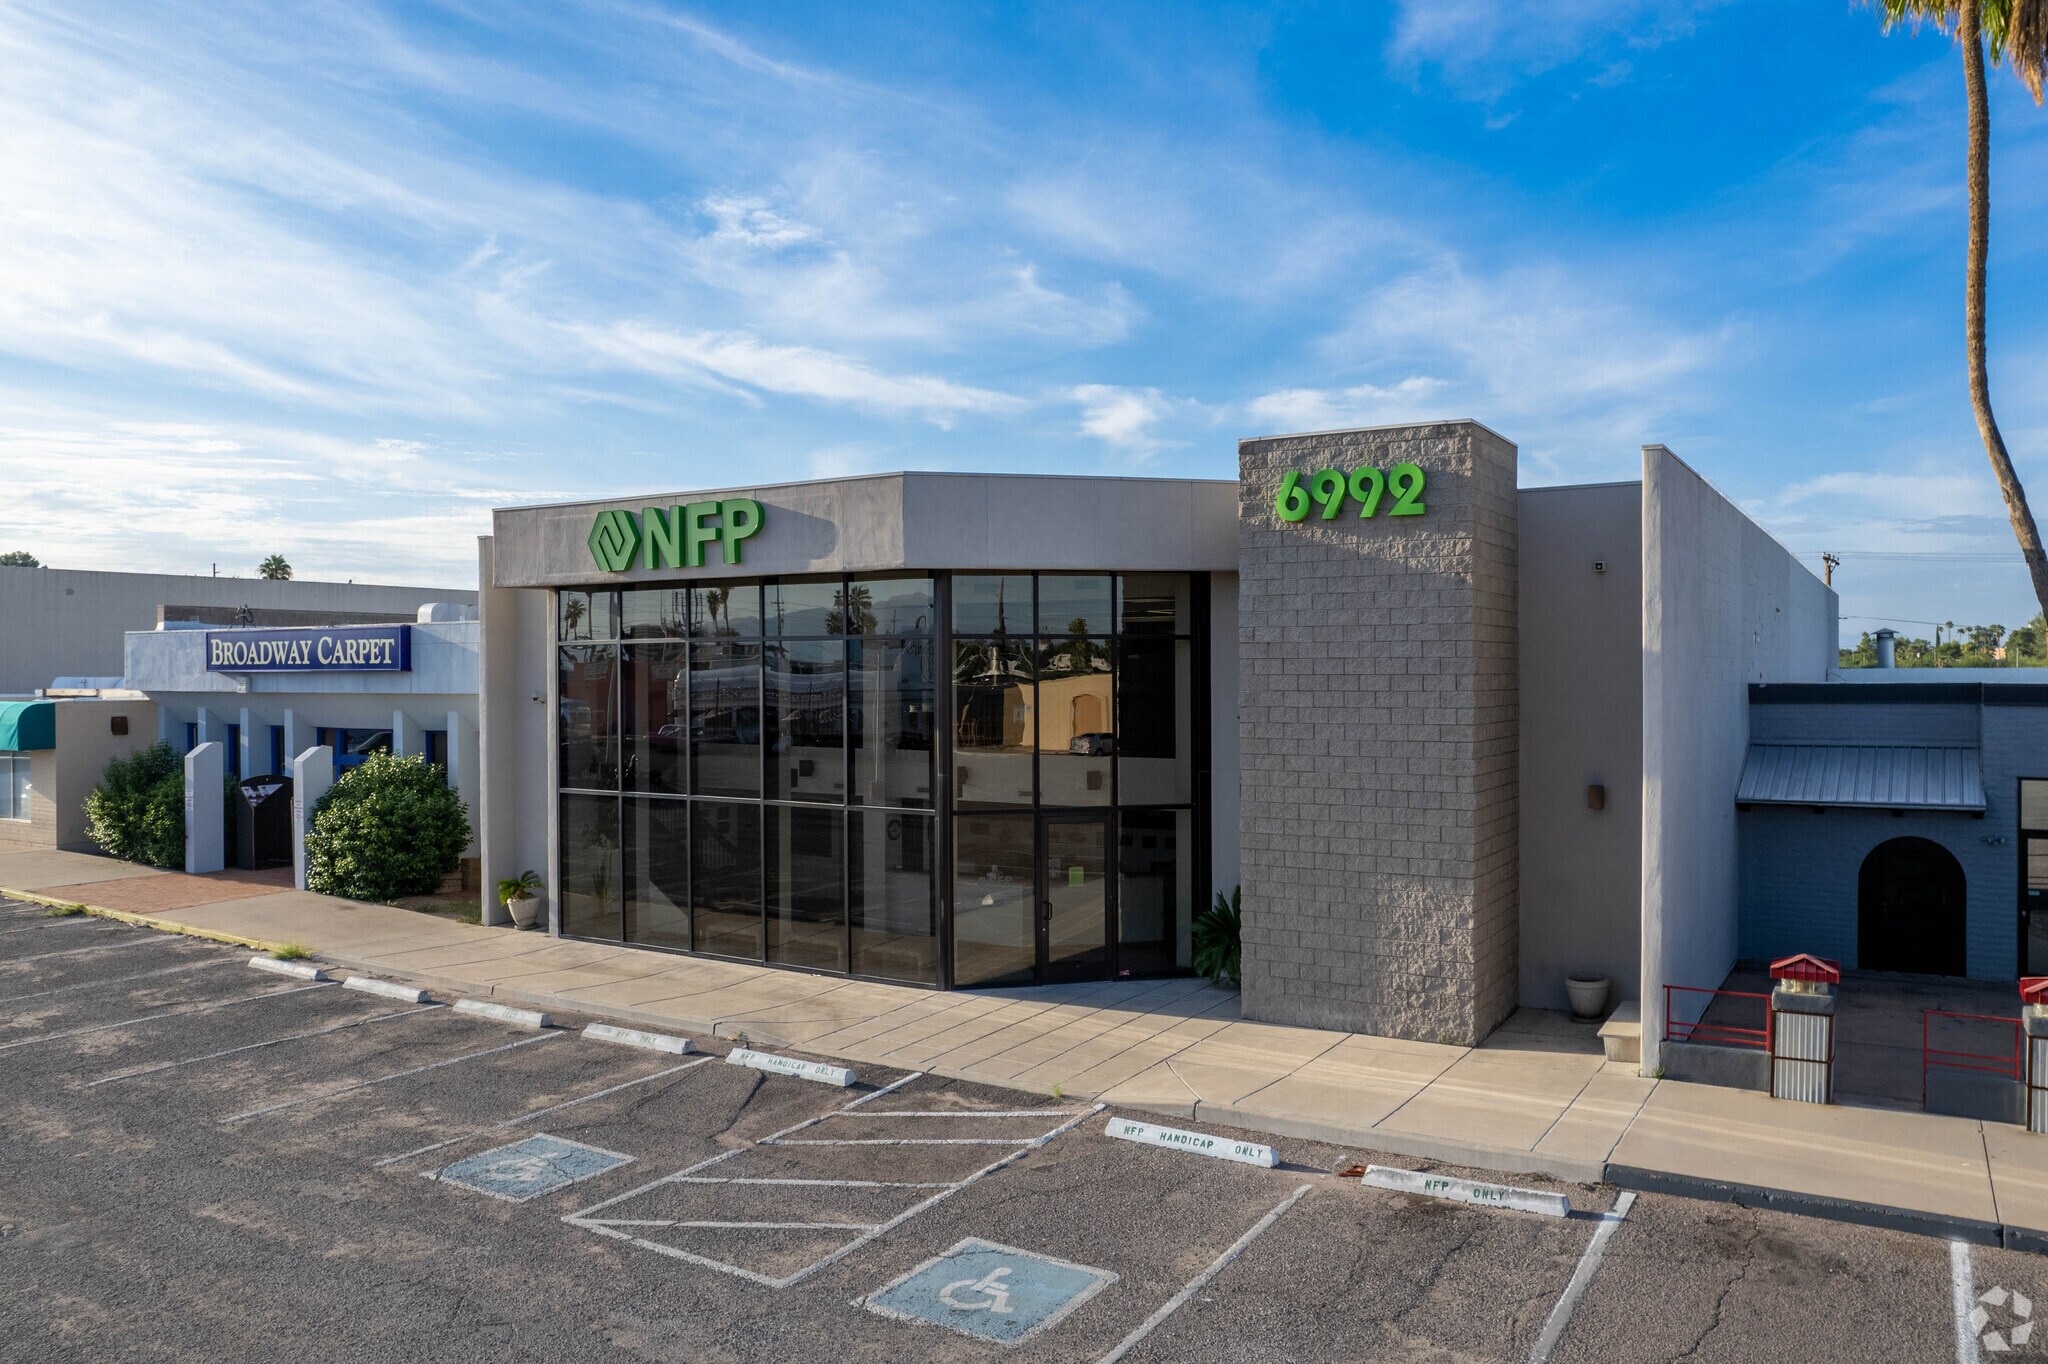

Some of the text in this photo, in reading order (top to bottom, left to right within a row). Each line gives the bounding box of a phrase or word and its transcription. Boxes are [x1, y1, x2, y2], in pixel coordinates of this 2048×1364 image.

[1275, 463, 1427, 522] 6992
[642, 498, 766, 570] NFP
[210, 636, 395, 666] BROADWAY CARPET
[739, 1051, 836, 1077] NFP HANDICAP ONLY
[1123, 1125, 1264, 1158] NFP HANDICAP ONLY
[1424, 1179, 1505, 1201] NFP ONLY
